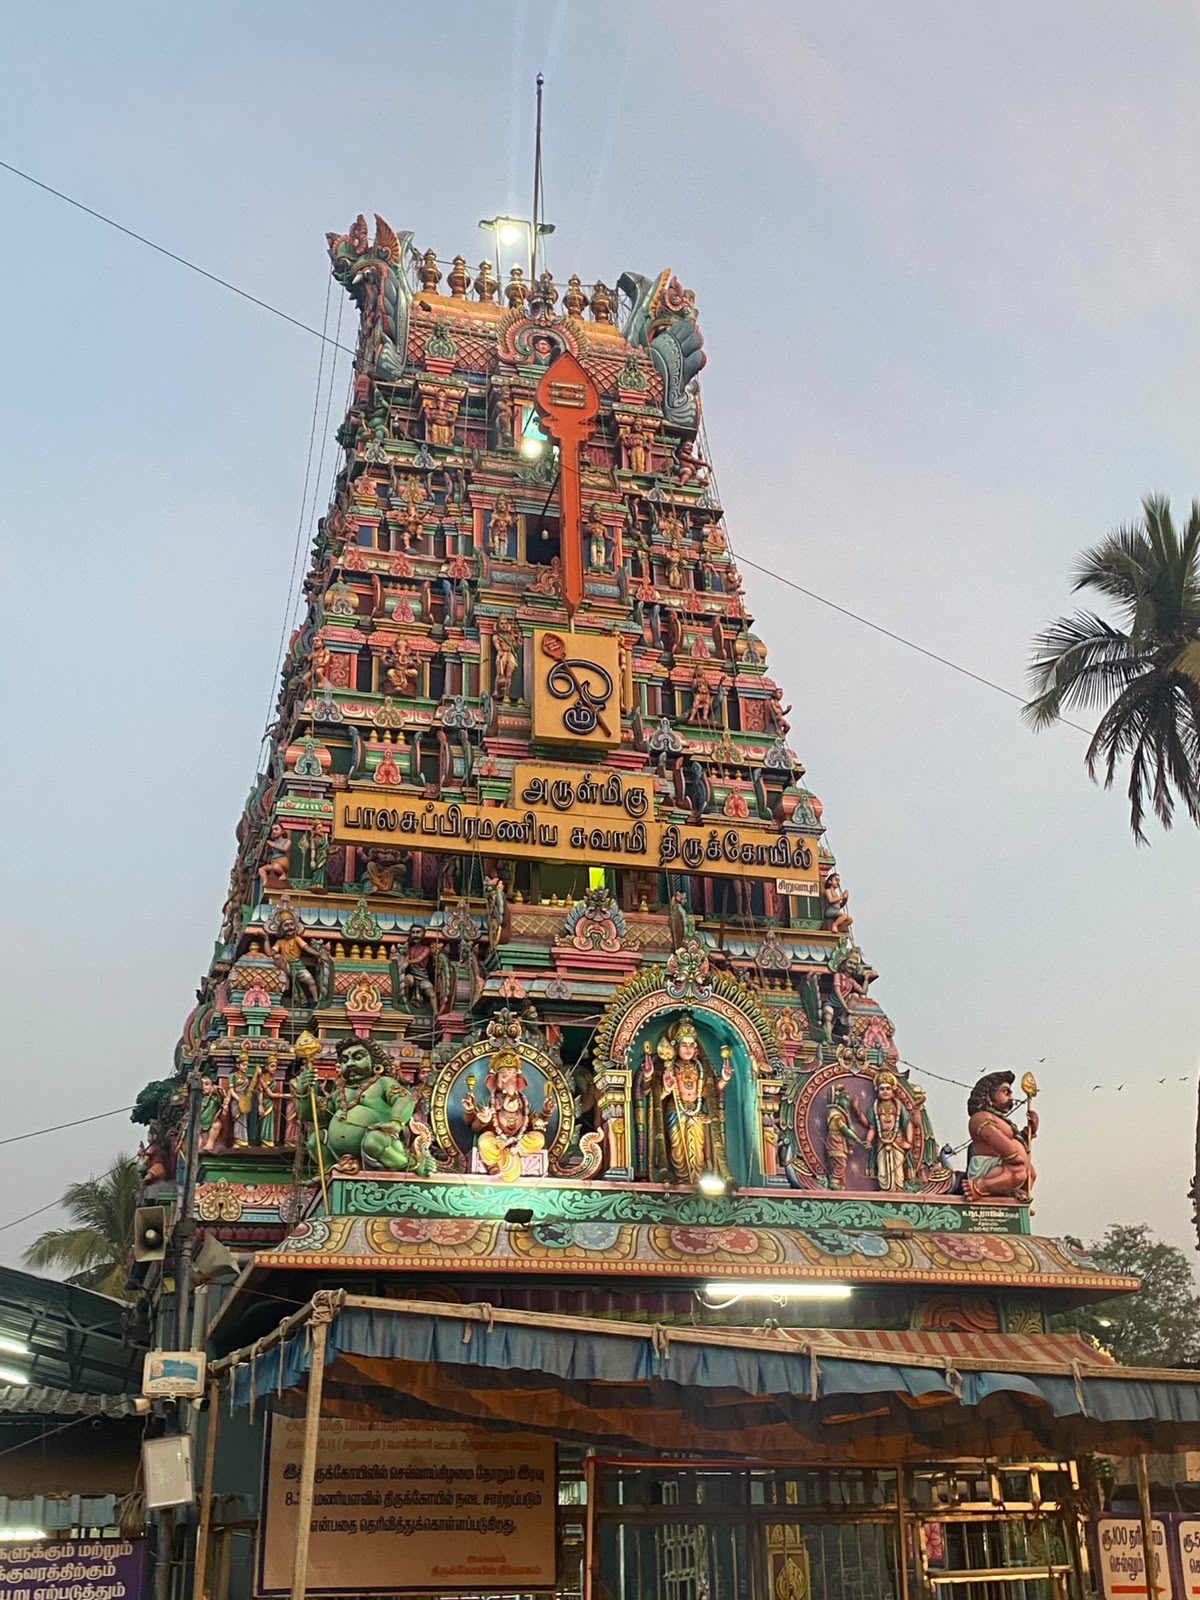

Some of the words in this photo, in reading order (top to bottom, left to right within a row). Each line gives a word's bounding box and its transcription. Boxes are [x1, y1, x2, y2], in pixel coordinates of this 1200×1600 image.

[521, 771, 649, 819] அருள்மிகு
[343, 801, 560, 847] பாலசுப்பிரமணிய
[569, 821, 648, 855] சுவாமி
[659, 823, 813, 870] திருக்கோயில்
[78, 1540, 133, 1561] மற்றும்
